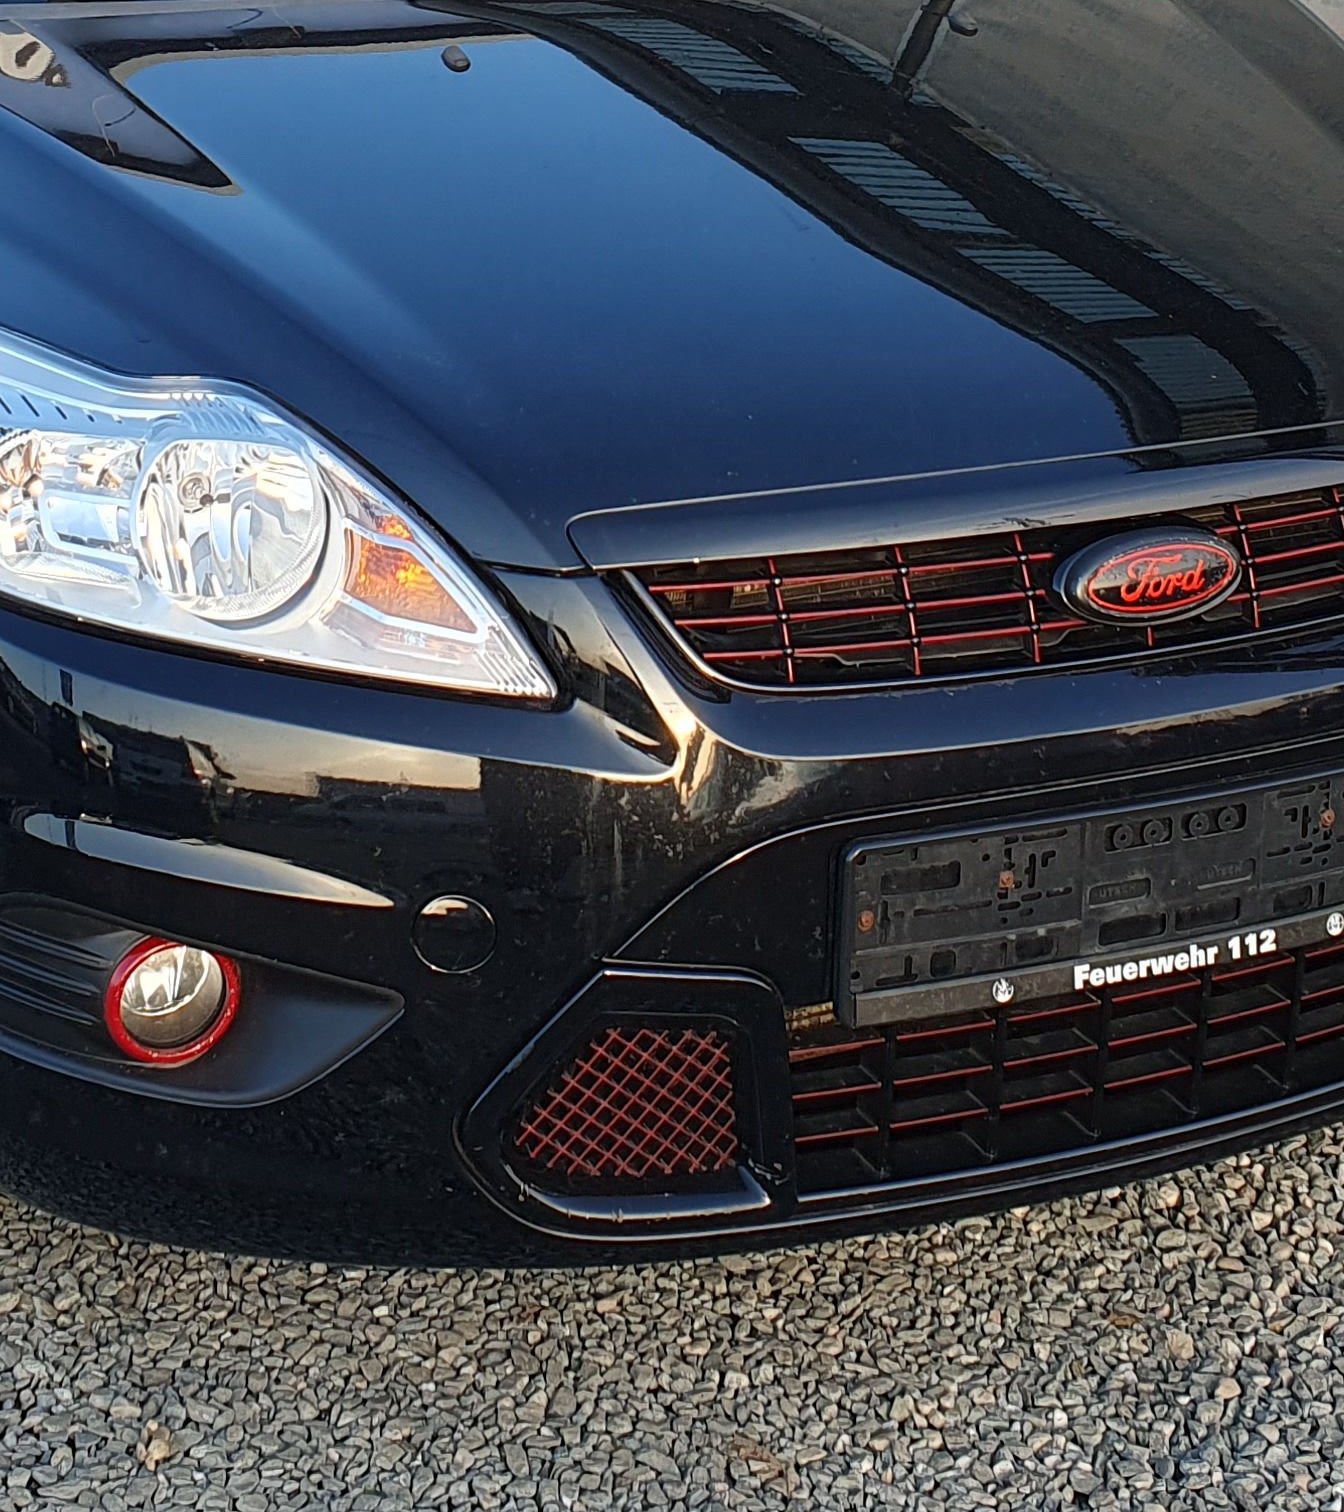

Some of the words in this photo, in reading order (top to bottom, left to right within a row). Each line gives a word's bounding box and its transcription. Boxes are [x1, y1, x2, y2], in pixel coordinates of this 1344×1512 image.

[1120, 553, 1206, 603] Ford
[1073, 944, 1219, 990] Feuerwehr
[1227, 929, 1277, 958] 112
